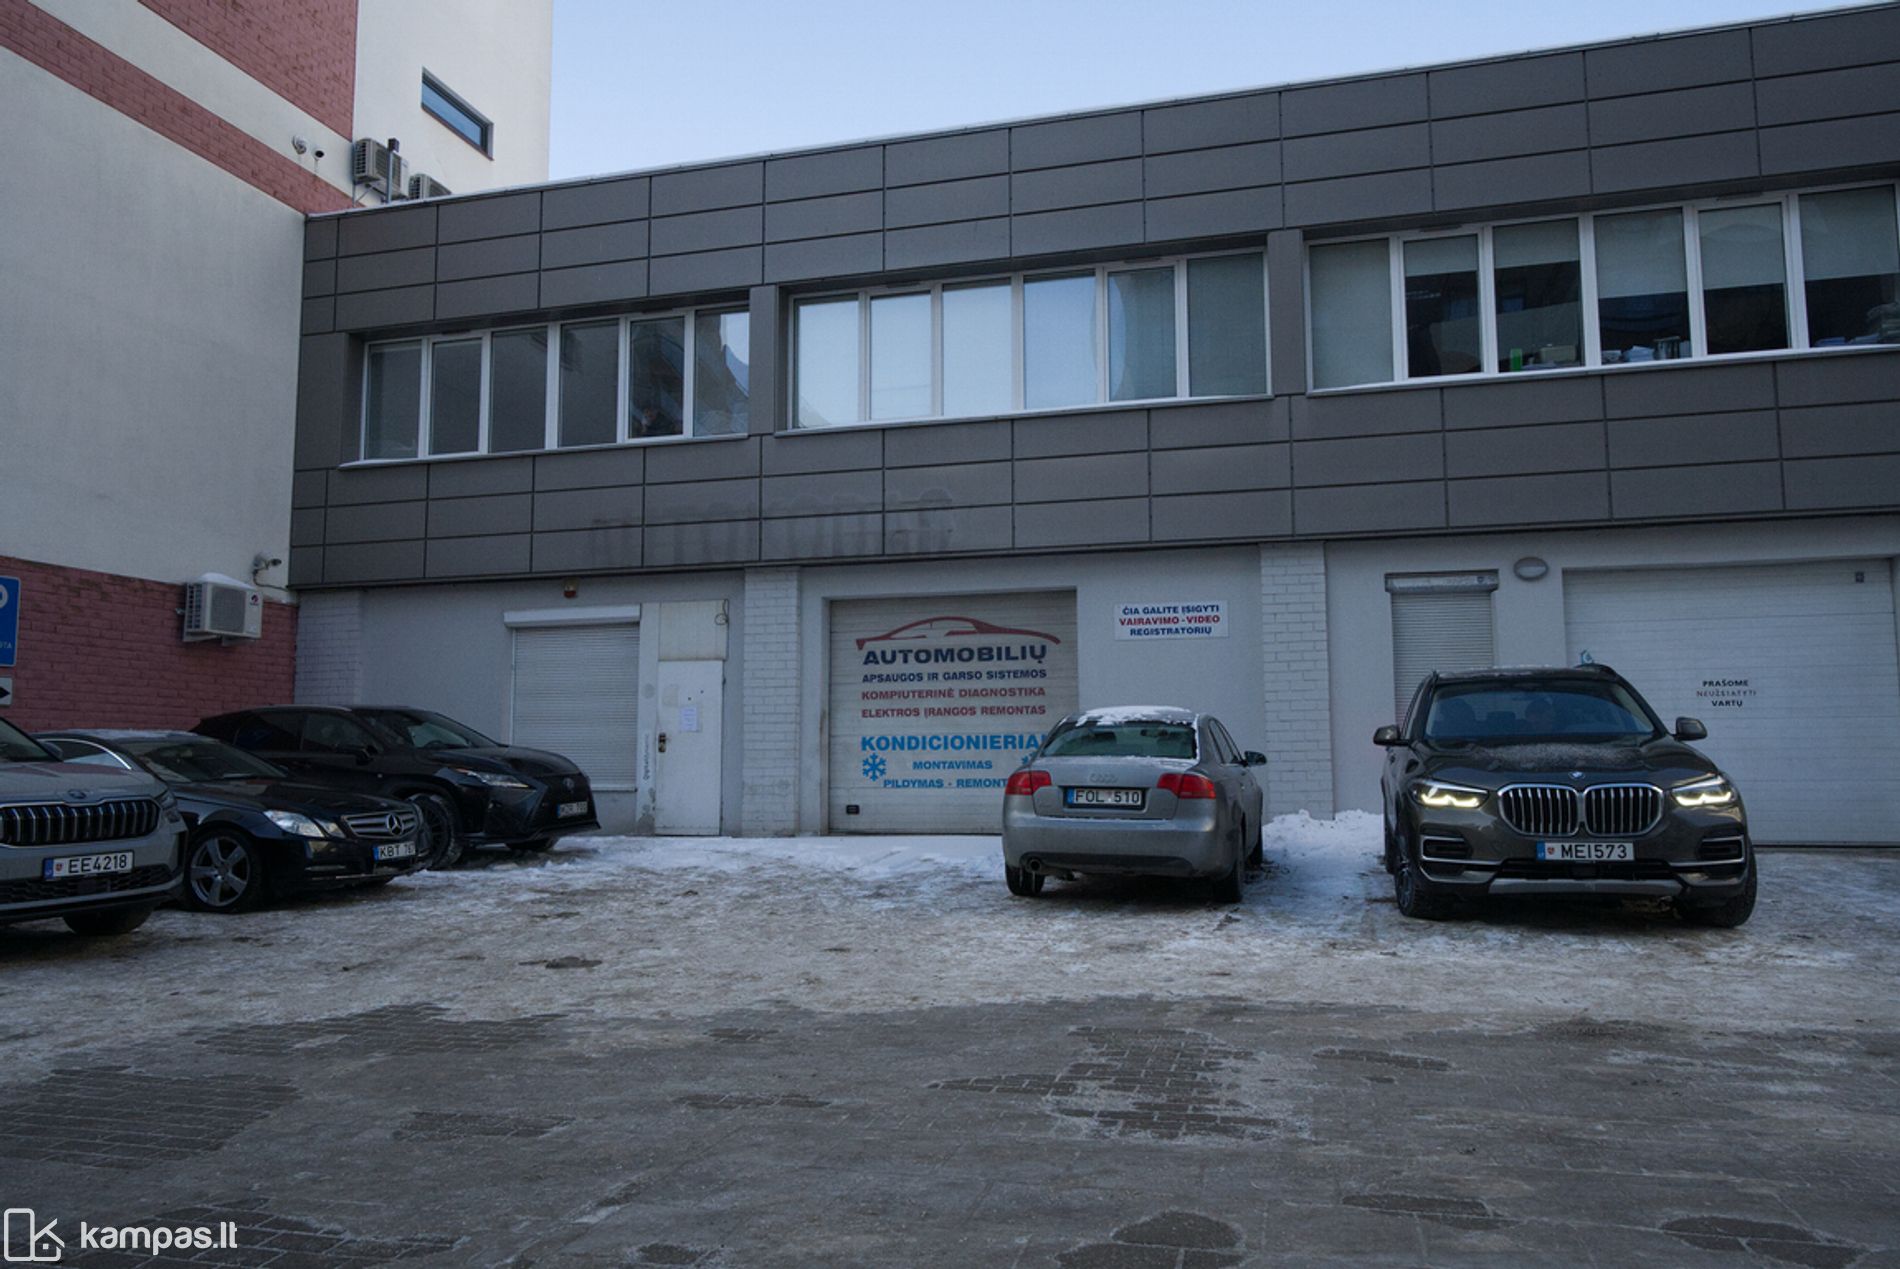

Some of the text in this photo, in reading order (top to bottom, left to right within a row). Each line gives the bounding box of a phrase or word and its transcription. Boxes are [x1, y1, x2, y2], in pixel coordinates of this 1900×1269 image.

[1142, 605, 1179, 615] GALITE
[1120, 616, 1179, 626] VAIRAVIMO
[1186, 615, 1220, 624] VIDEO
[862, 644, 1047, 665] AUTOMOBILIŲ
[862, 669, 1047, 683] APSAUGOS IR GARSO SISTEMOS
[1702, 679, 1748, 687] PRAŠOME
[861, 687, 1046, 700] KOMPIUTERINĖ DIAGNOSTIKA
[1711, 700, 1743, 708] VARTŲ
[861, 705, 1046, 719] ELEKTROS ĮRANGOS REMONTAS
[912, 760, 993, 770] MONTAVIMAS
[883, 778, 944, 788] PILDYMAS
[956, 778, 1008, 788] REMONT
[1075, 790, 1139, 803] FOL 510
[380, 844, 400, 857] KBT
[68, 854, 127, 873] EE4218
